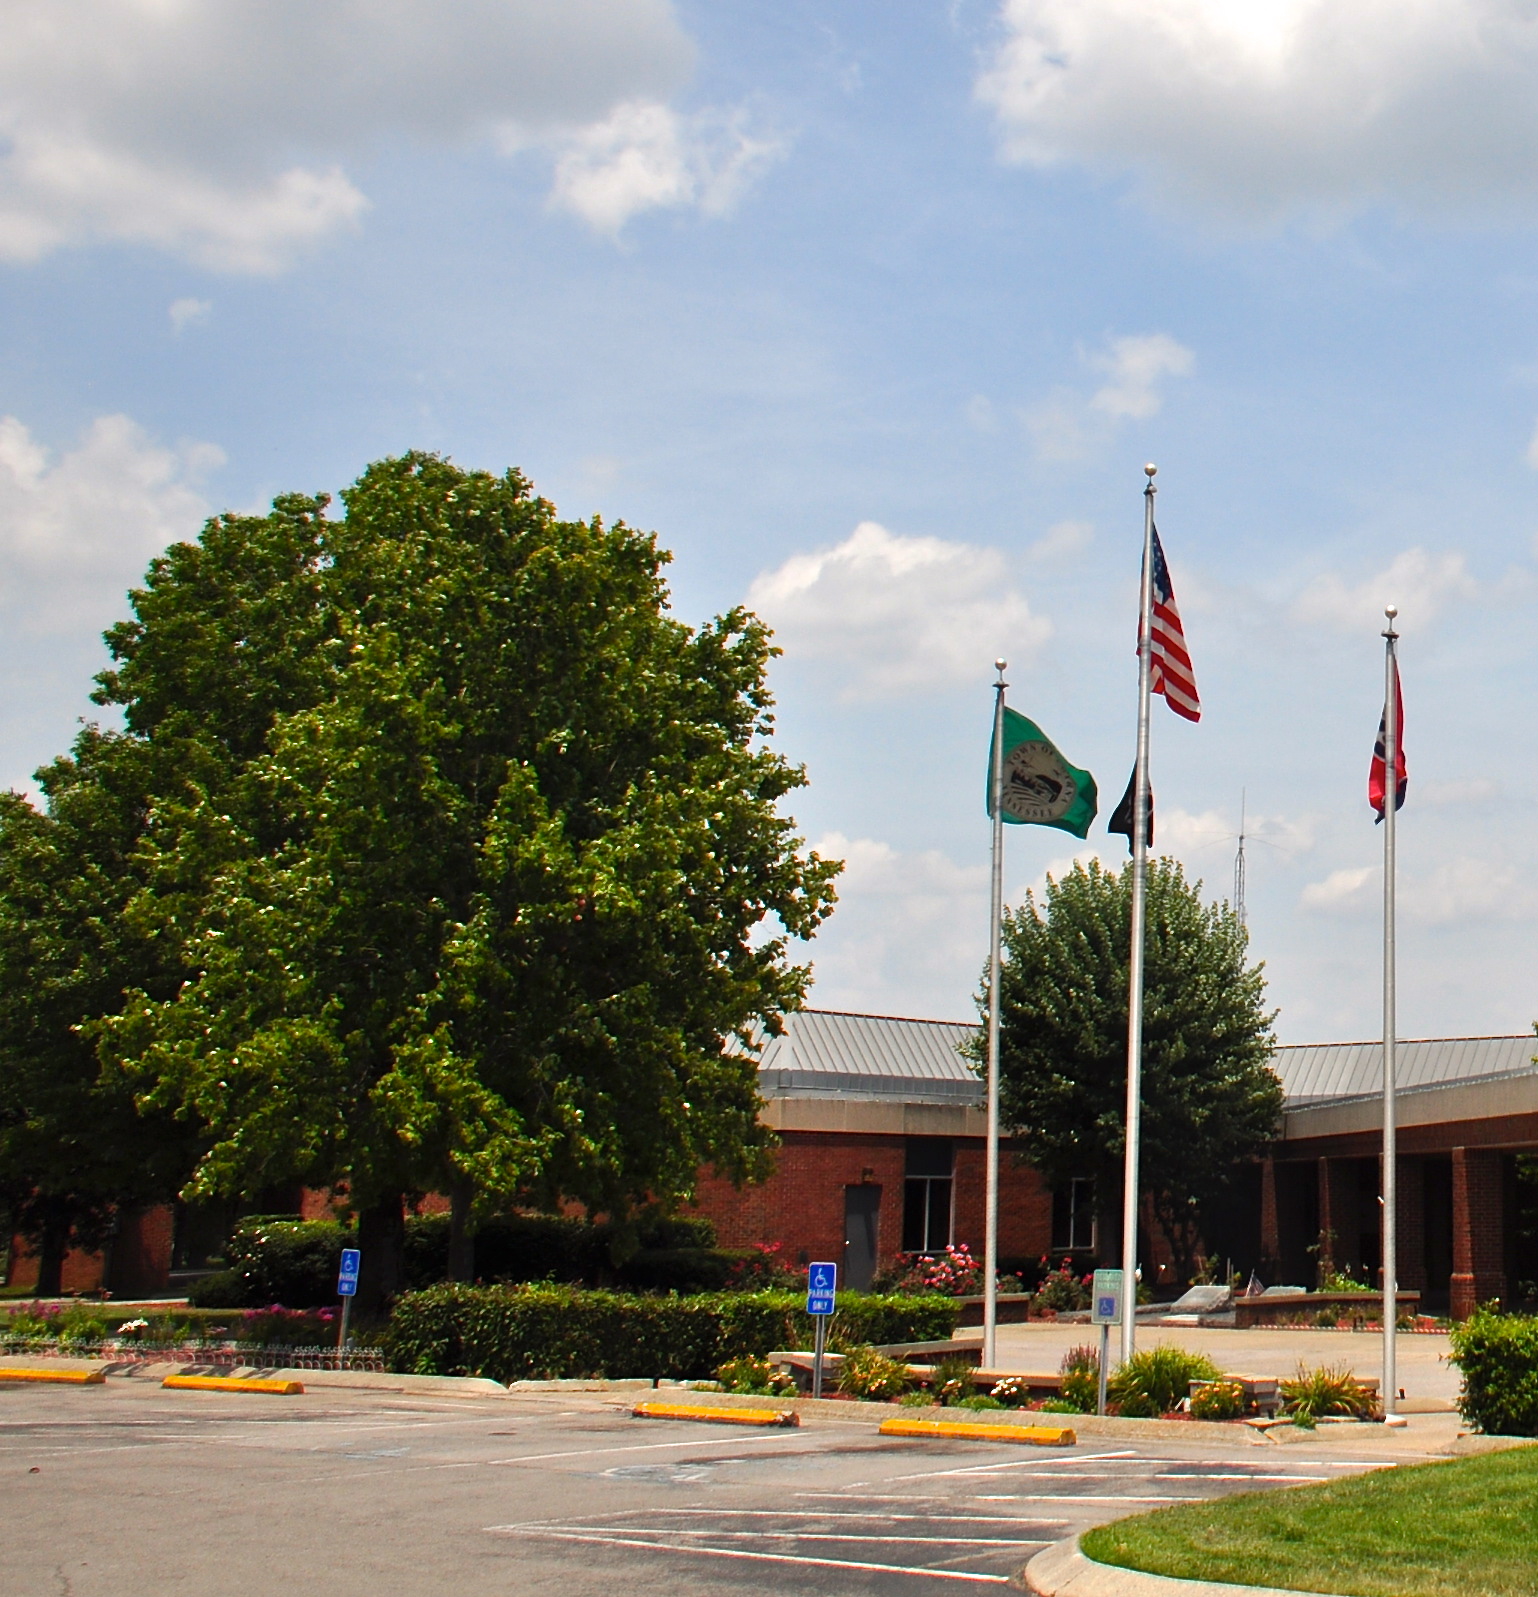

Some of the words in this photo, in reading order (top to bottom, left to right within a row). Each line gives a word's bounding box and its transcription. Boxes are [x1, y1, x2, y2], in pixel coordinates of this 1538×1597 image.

[1007, 743, 1037, 767] TOWN
[808, 1289, 834, 1299] PARKING
[812, 1300, 828, 1311] ONLY
